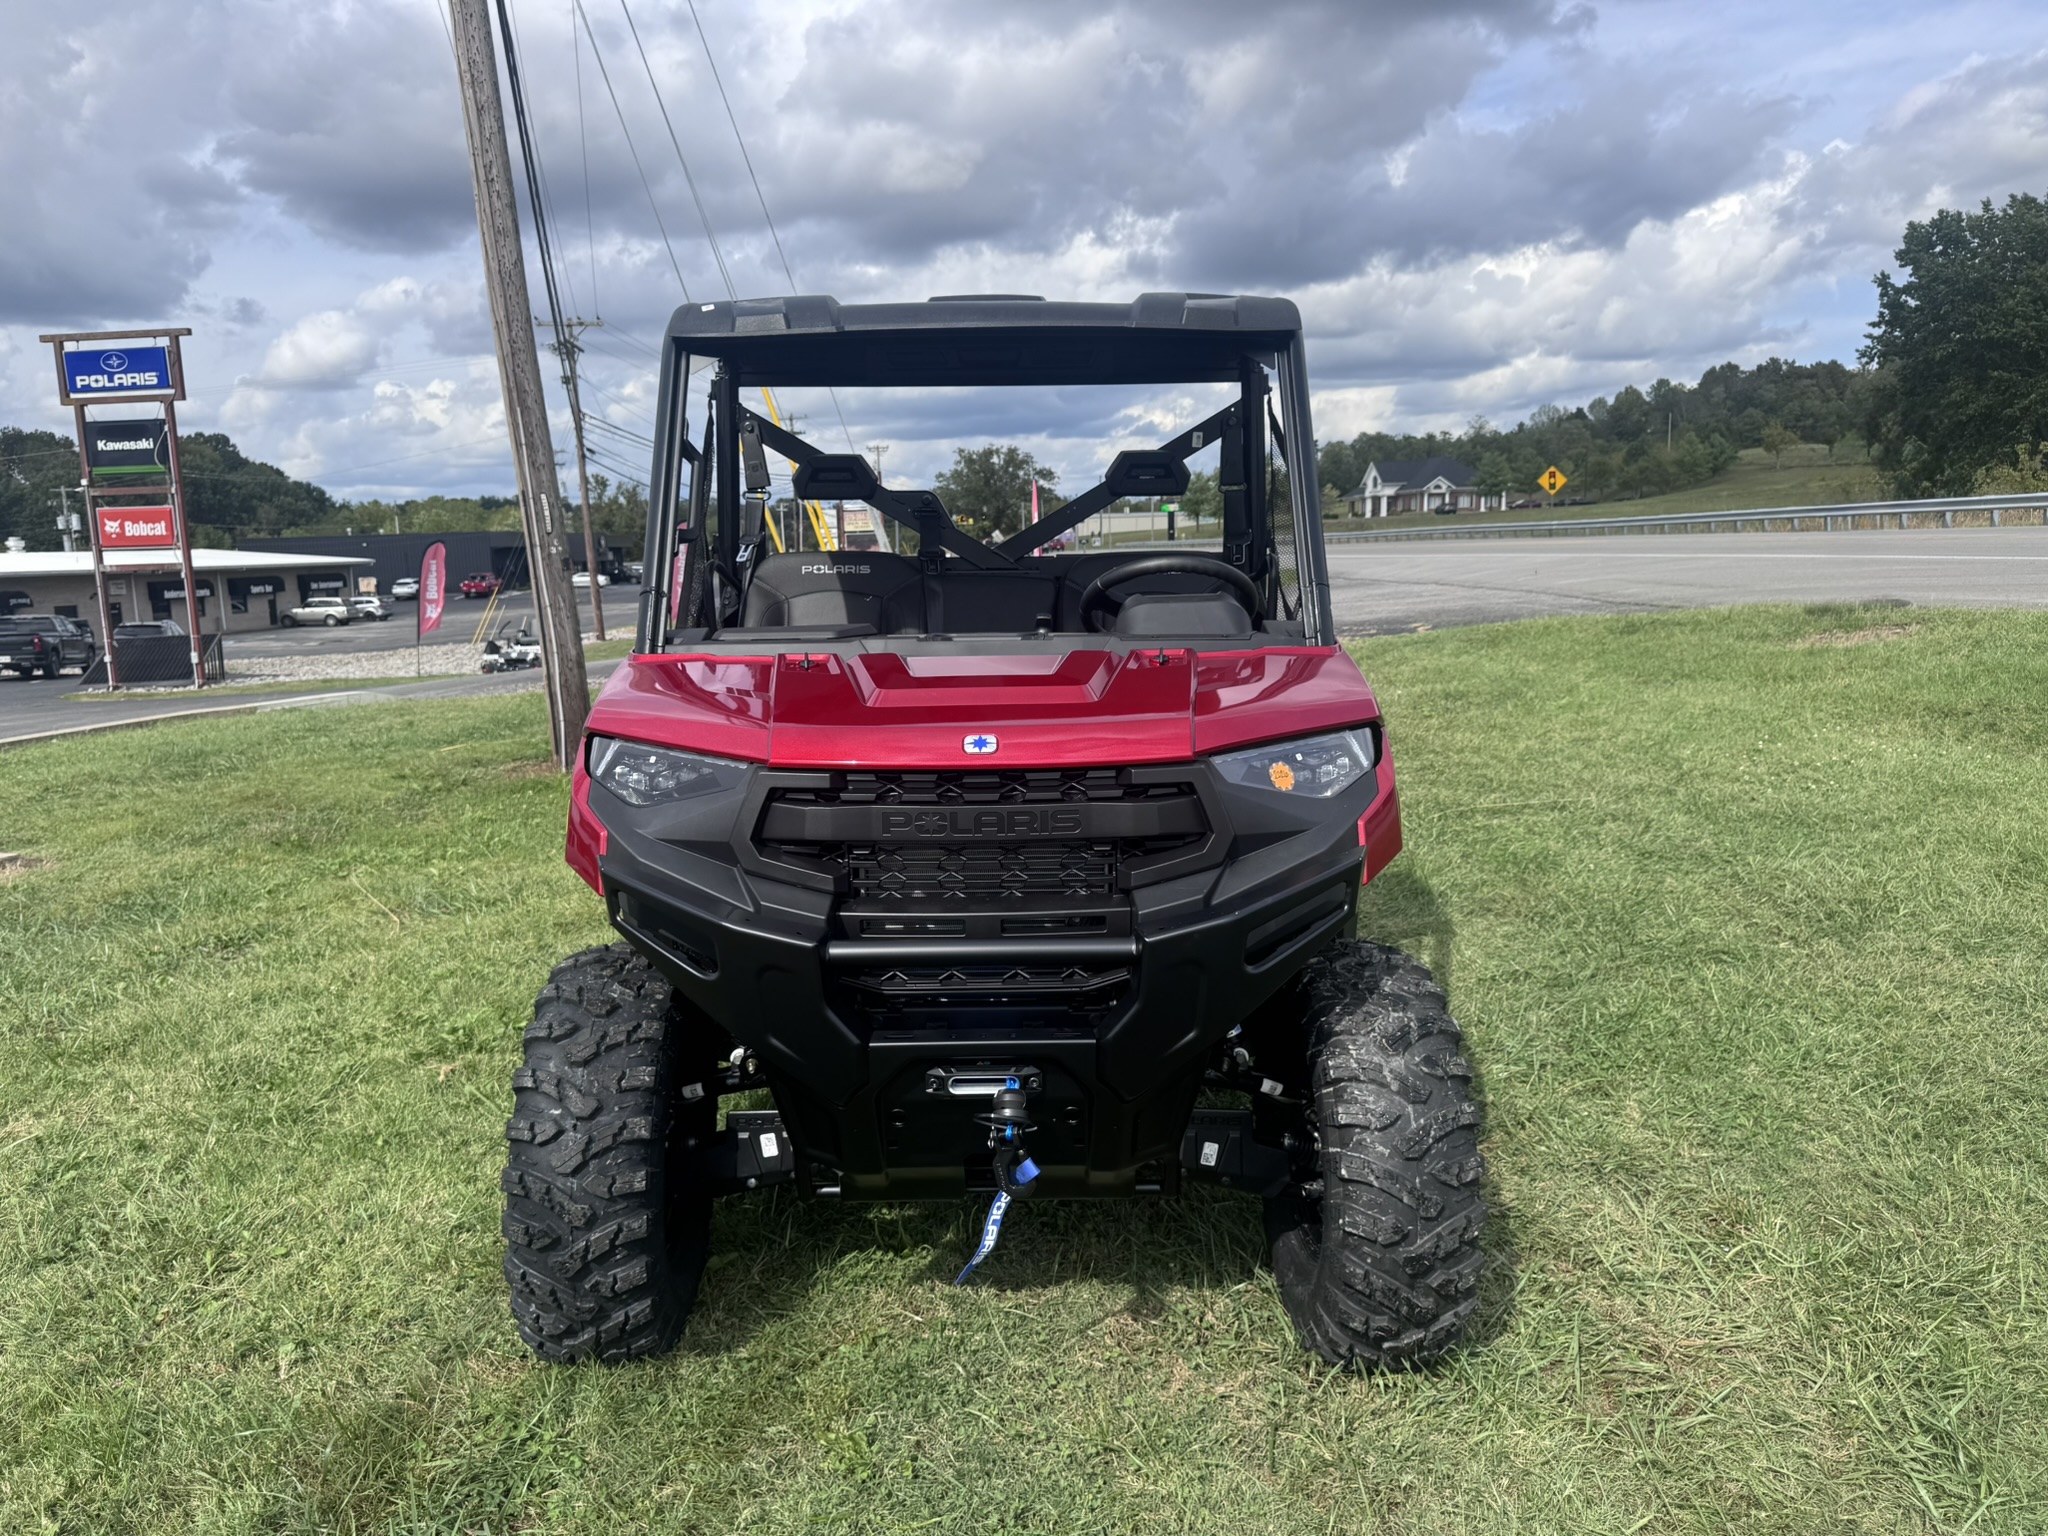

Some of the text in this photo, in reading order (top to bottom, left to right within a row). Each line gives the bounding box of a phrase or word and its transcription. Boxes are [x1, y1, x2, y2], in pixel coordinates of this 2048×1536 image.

[75, 372, 158, 388] POLARIS
[97, 438, 154, 451] Kawasaki
[124, 520, 167, 536] Bobcat
[801, 565, 871, 574] POLARIS
[425, 560, 438, 599] Bobcat
[881, 809, 1082, 837] POLARIS
[972, 1191, 1011, 1265] POLARIS
